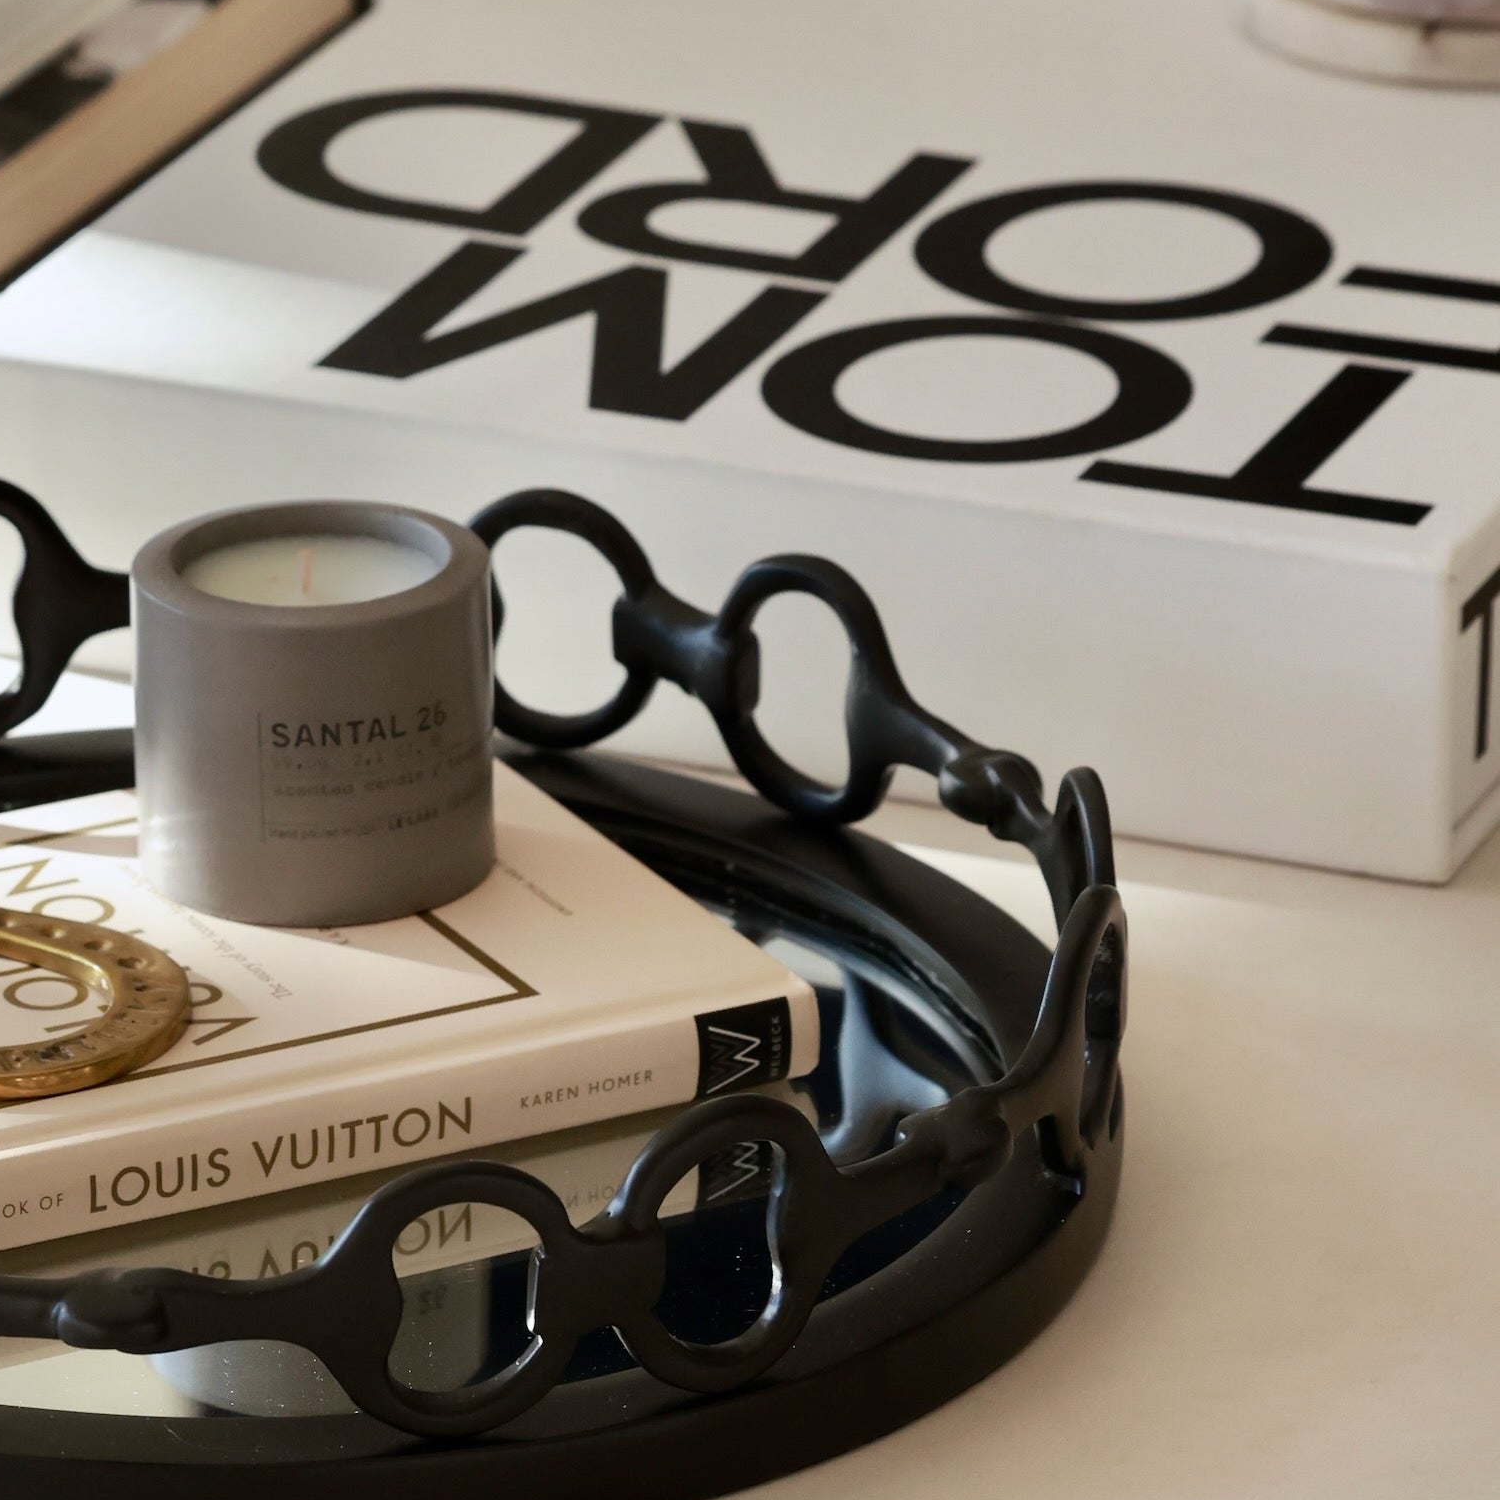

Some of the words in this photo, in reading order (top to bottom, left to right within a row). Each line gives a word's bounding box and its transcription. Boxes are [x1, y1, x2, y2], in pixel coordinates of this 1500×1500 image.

[314, 241, 1434, 526] TOM
[272, 716, 406, 748] SANTAL
[417, 702, 447, 732] 26
[520, 1085, 579, 1109] KAREN
[588, 1069, 654, 1096] HOMER
[39, 1193, 64, 1211] OF
[89, 1148, 231, 1214] LOUIS
[252, 1096, 472, 1179] VUITTON
